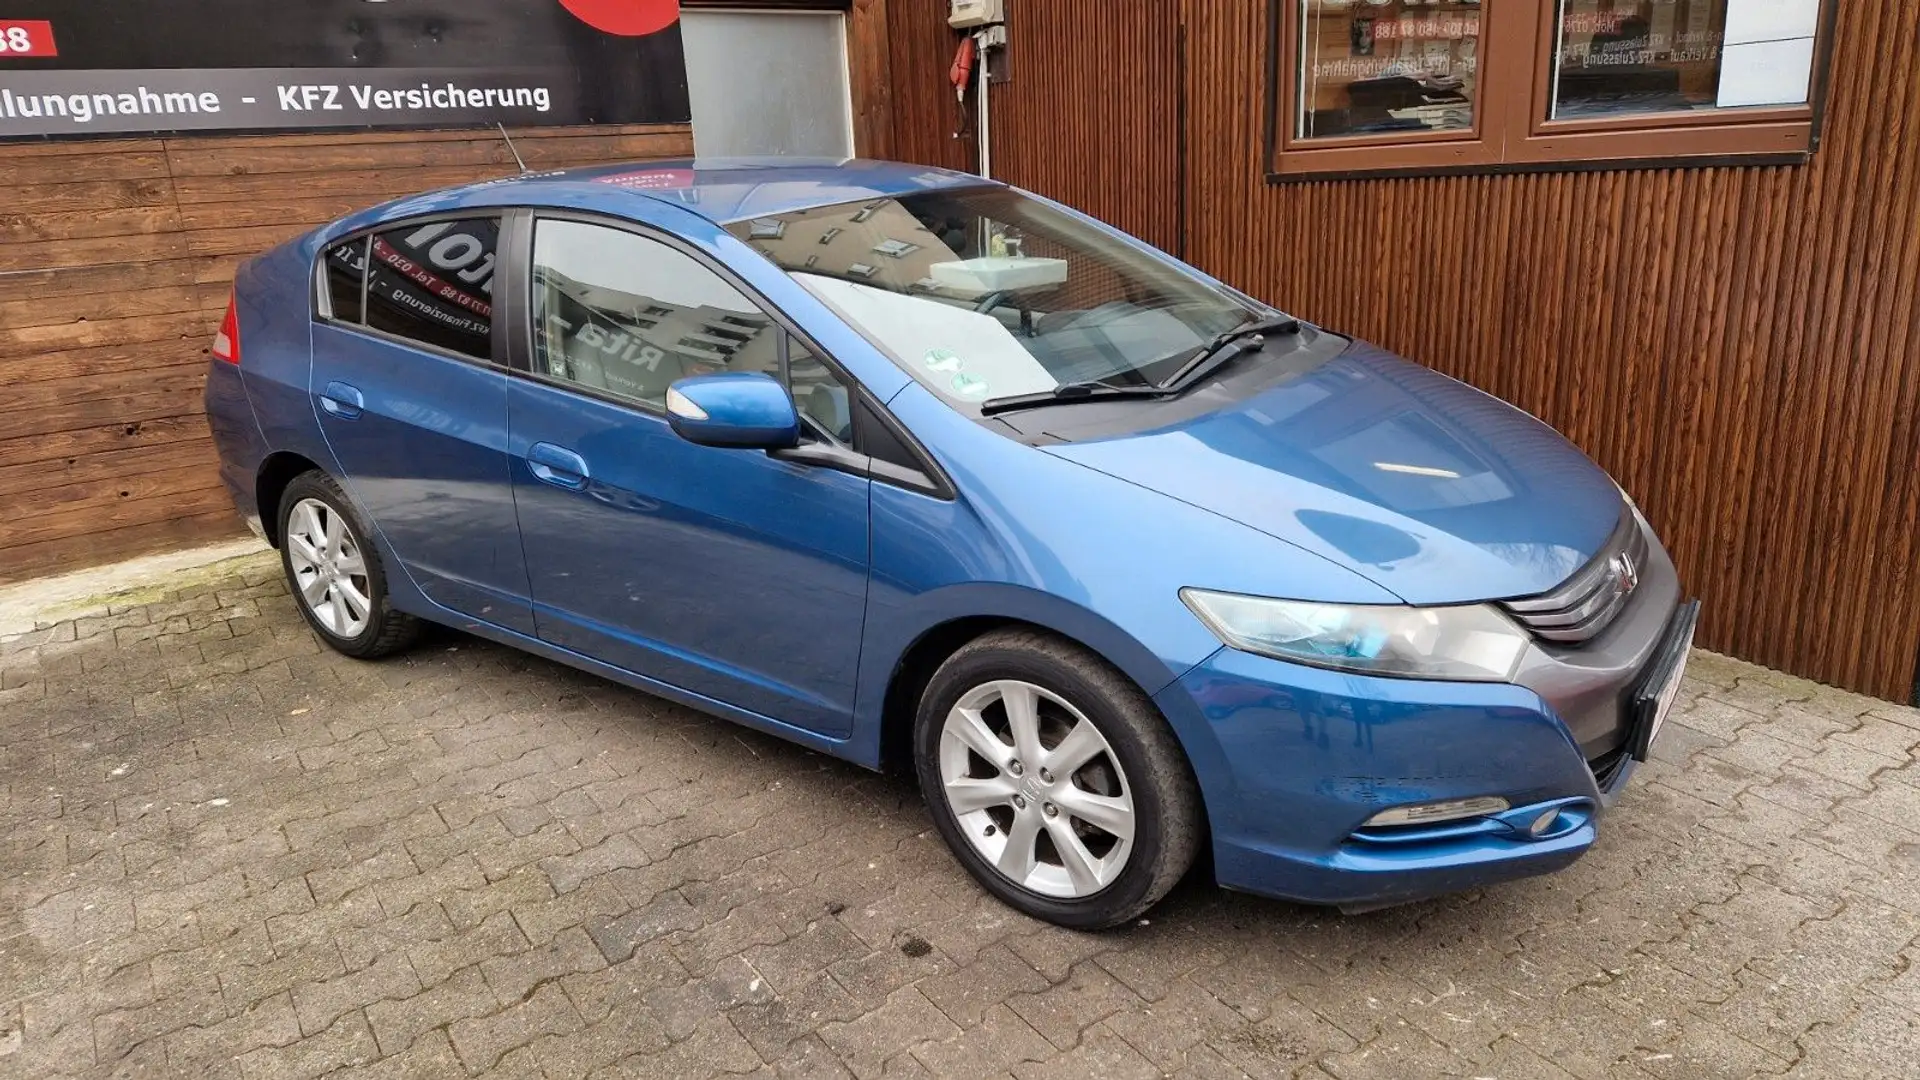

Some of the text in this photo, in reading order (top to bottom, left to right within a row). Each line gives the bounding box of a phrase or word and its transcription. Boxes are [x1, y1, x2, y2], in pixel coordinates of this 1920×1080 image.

[0, 87, 220, 122] lungnahme
[277, 85, 343, 110] KFZ
[349, 83, 549, 112] Versicherung
